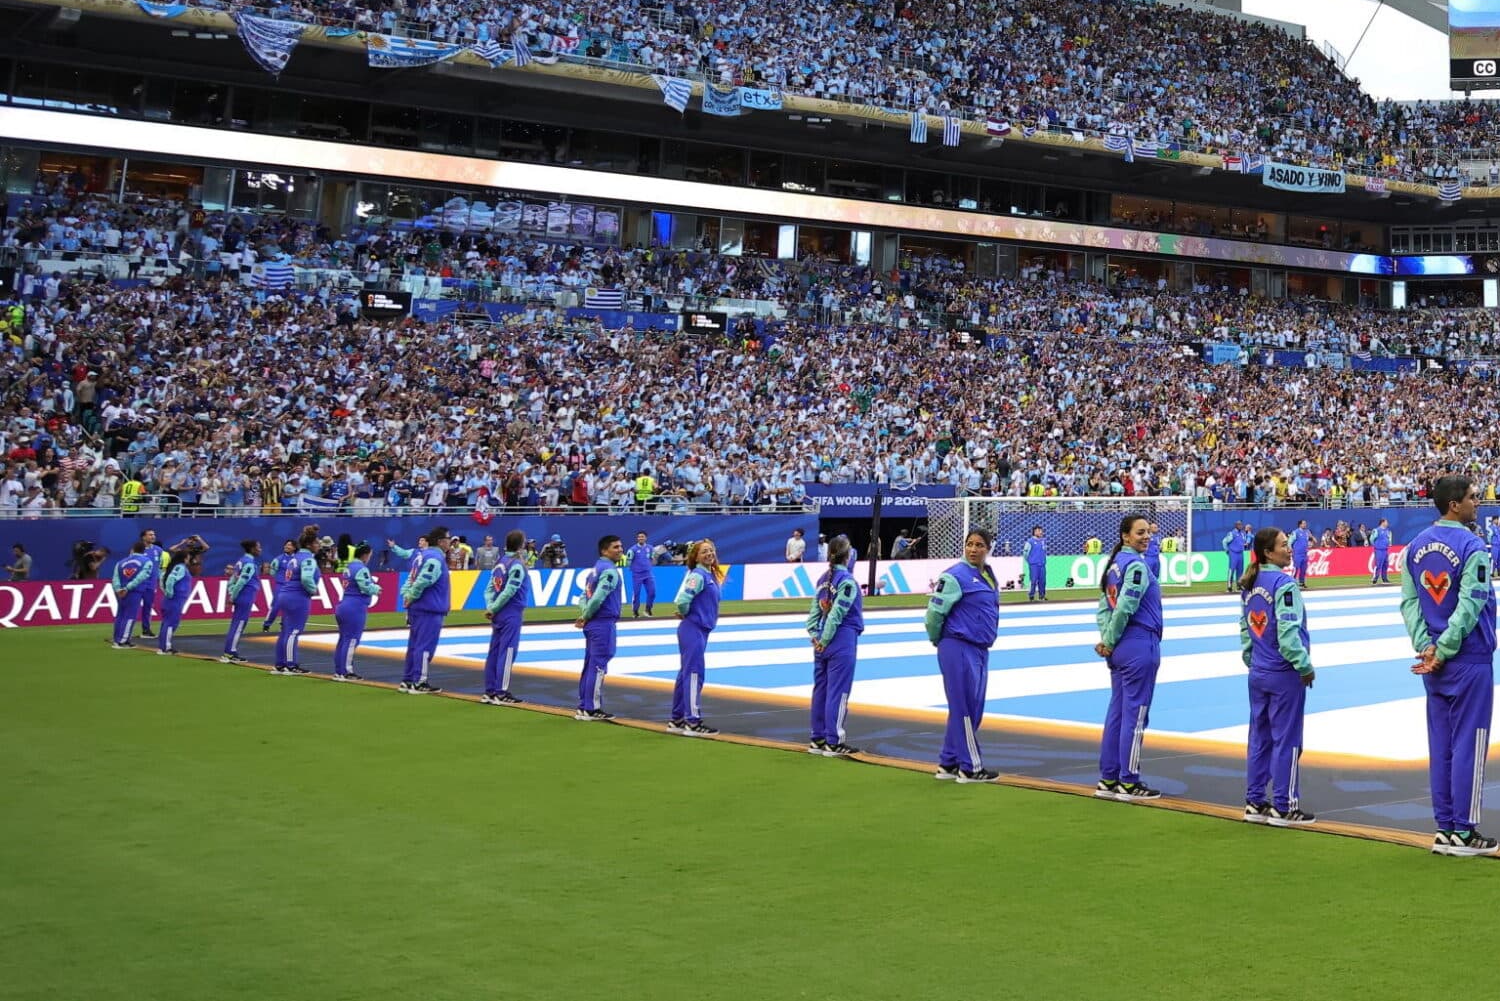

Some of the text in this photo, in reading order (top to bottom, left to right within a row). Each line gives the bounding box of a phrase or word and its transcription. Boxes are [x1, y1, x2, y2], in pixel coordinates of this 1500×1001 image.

[1475, 61, 1495, 74] CC
[1269, 167, 1342, 187] ASADO Y VINO
[813, 497, 834, 506] FIFA
[836, 497, 872, 506] WORLD
[873, 497, 893, 506] UP
[1413, 542, 1461, 567] VOLUNTEER
[0, 581, 158, 628] QATA
